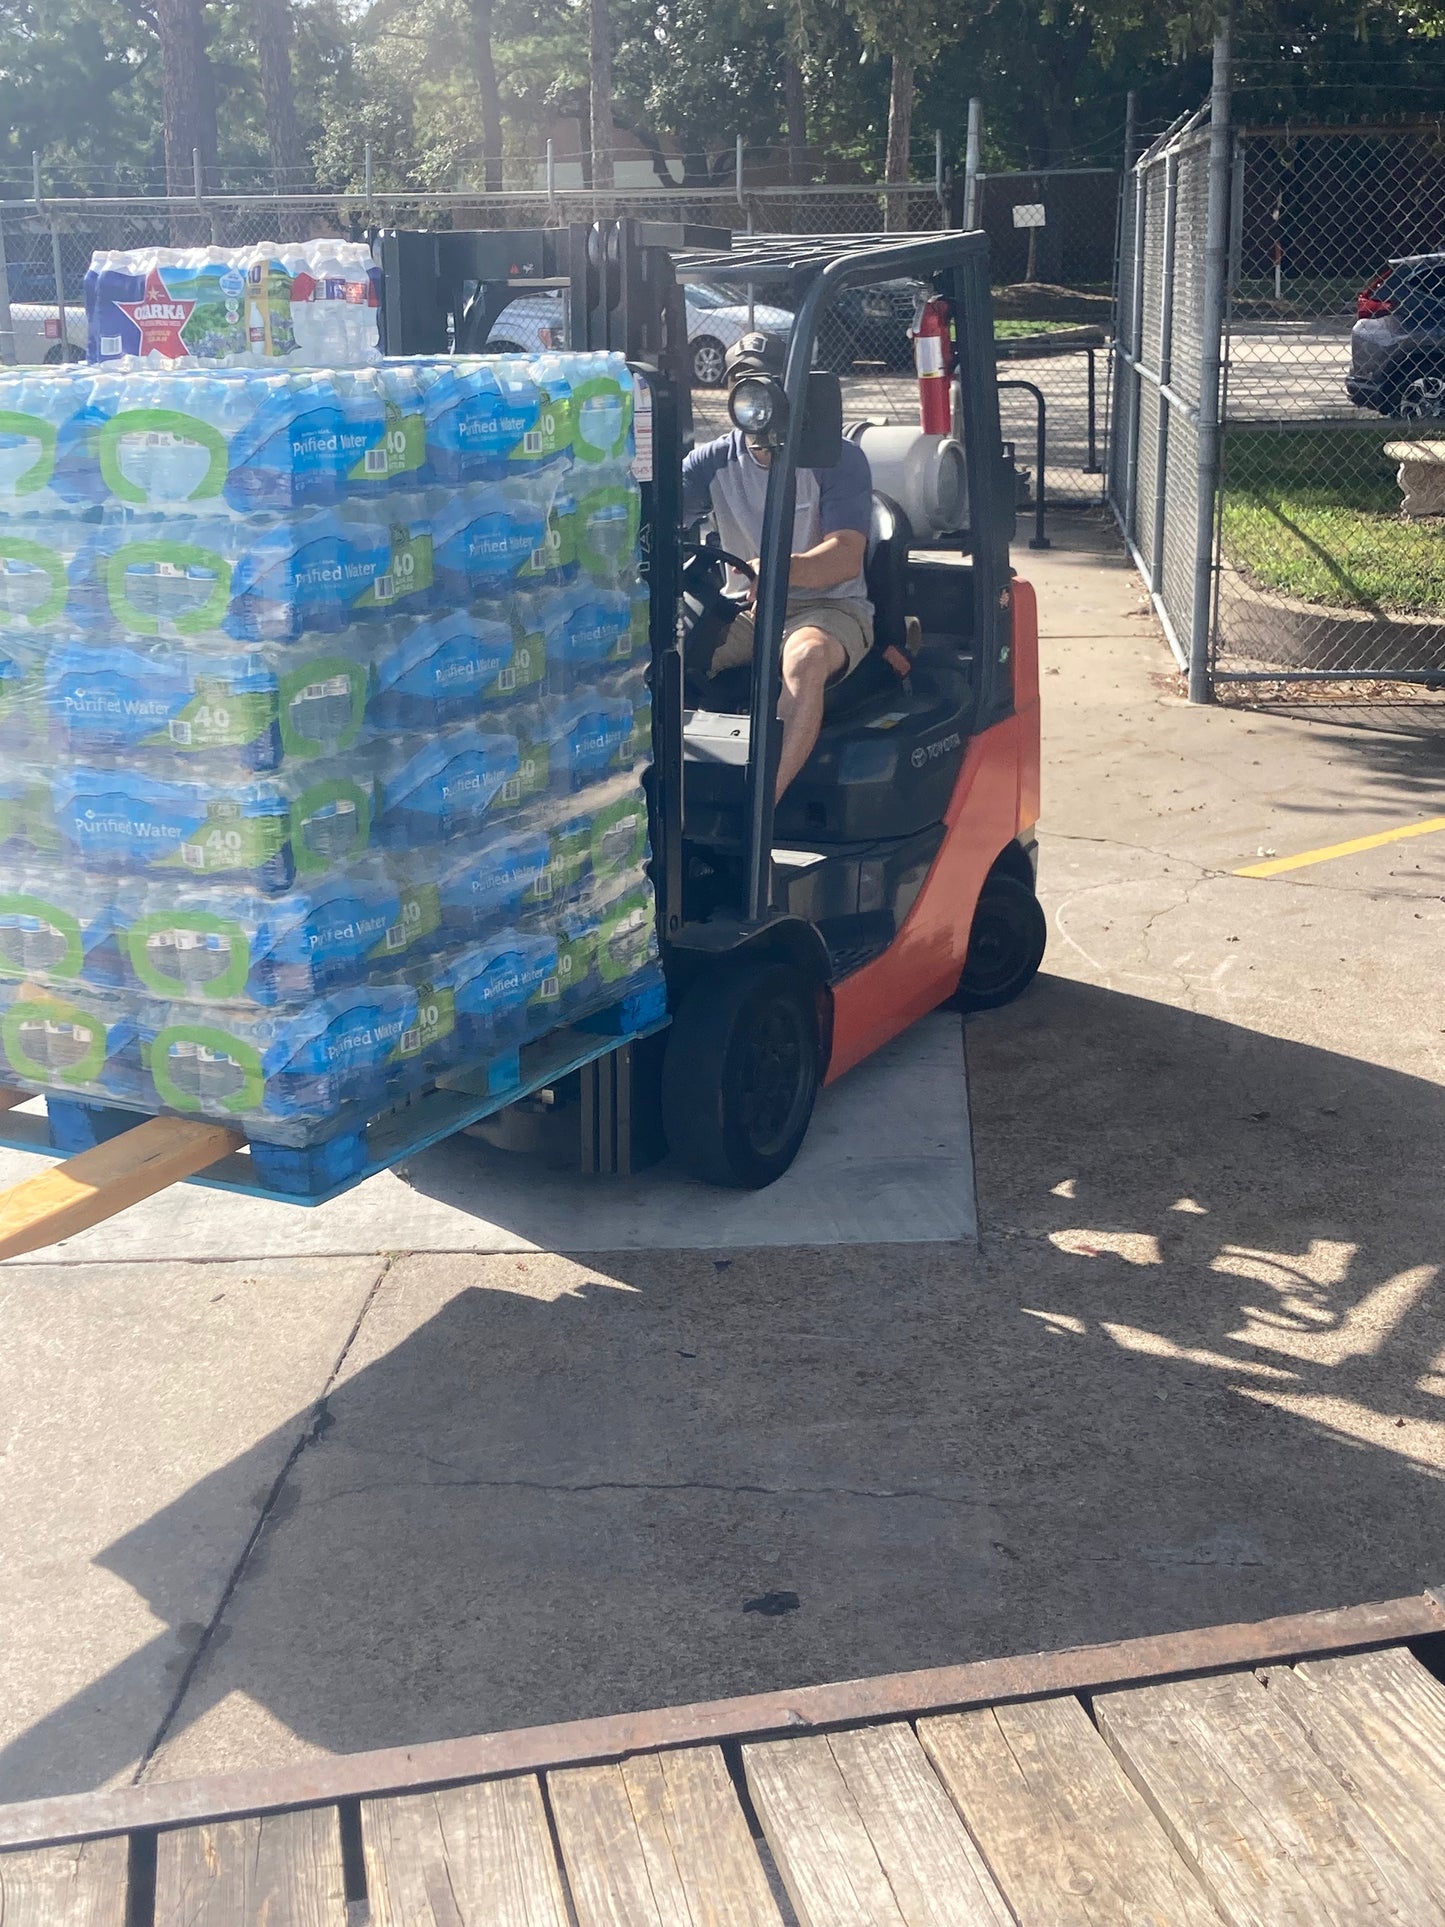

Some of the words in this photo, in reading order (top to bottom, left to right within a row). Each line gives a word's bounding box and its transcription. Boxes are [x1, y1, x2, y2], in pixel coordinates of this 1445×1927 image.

[393, 552, 415, 578] 40
[124, 700, 170, 716] Water
[194, 705, 230, 729] 40
[926, 732, 960, 760] TOYOTA
[75, 818, 132, 836] Purified
[133, 822, 182, 838] Water
[206, 829, 242, 851] 40
